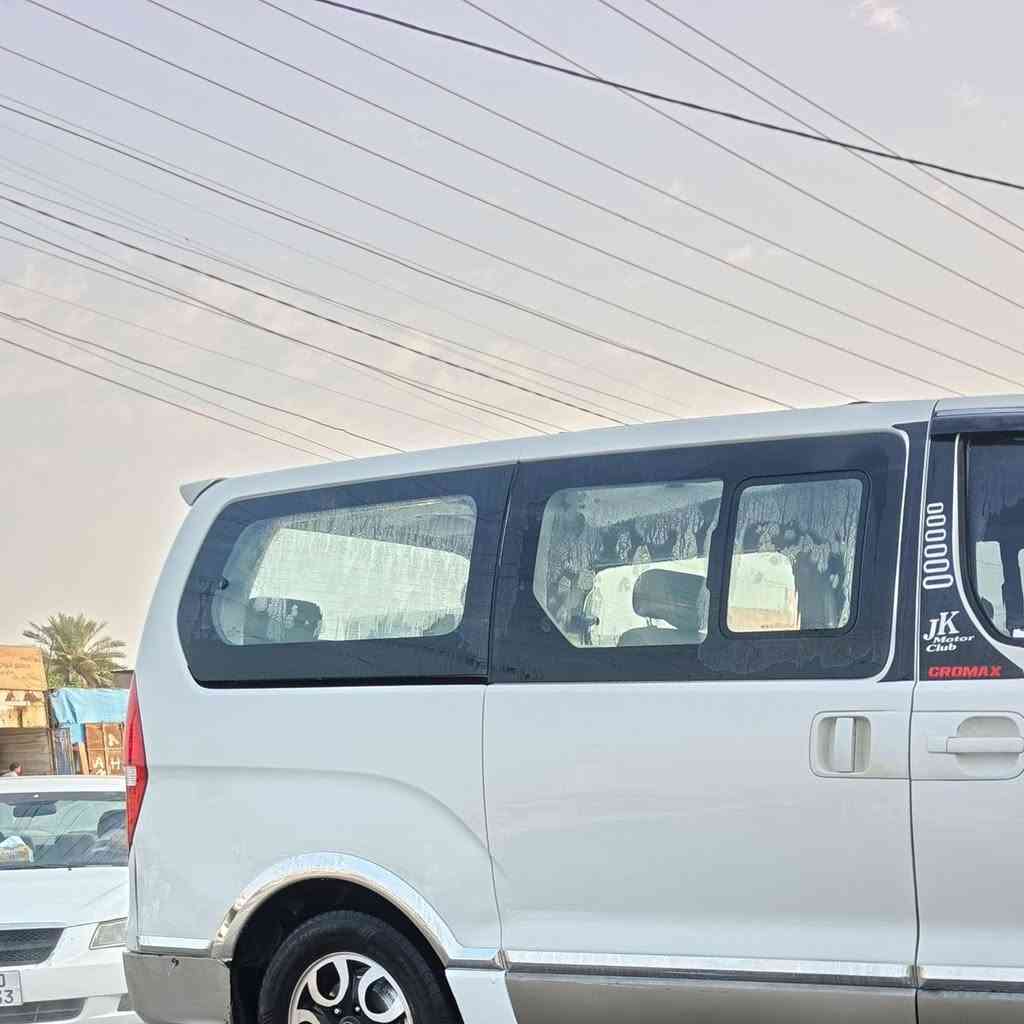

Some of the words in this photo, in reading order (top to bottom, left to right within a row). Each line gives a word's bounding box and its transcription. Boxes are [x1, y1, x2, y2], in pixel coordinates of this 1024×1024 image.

[923, 611, 960, 640] JK
[933, 635, 976, 643] Motor
[926, 643, 957, 652] Club
